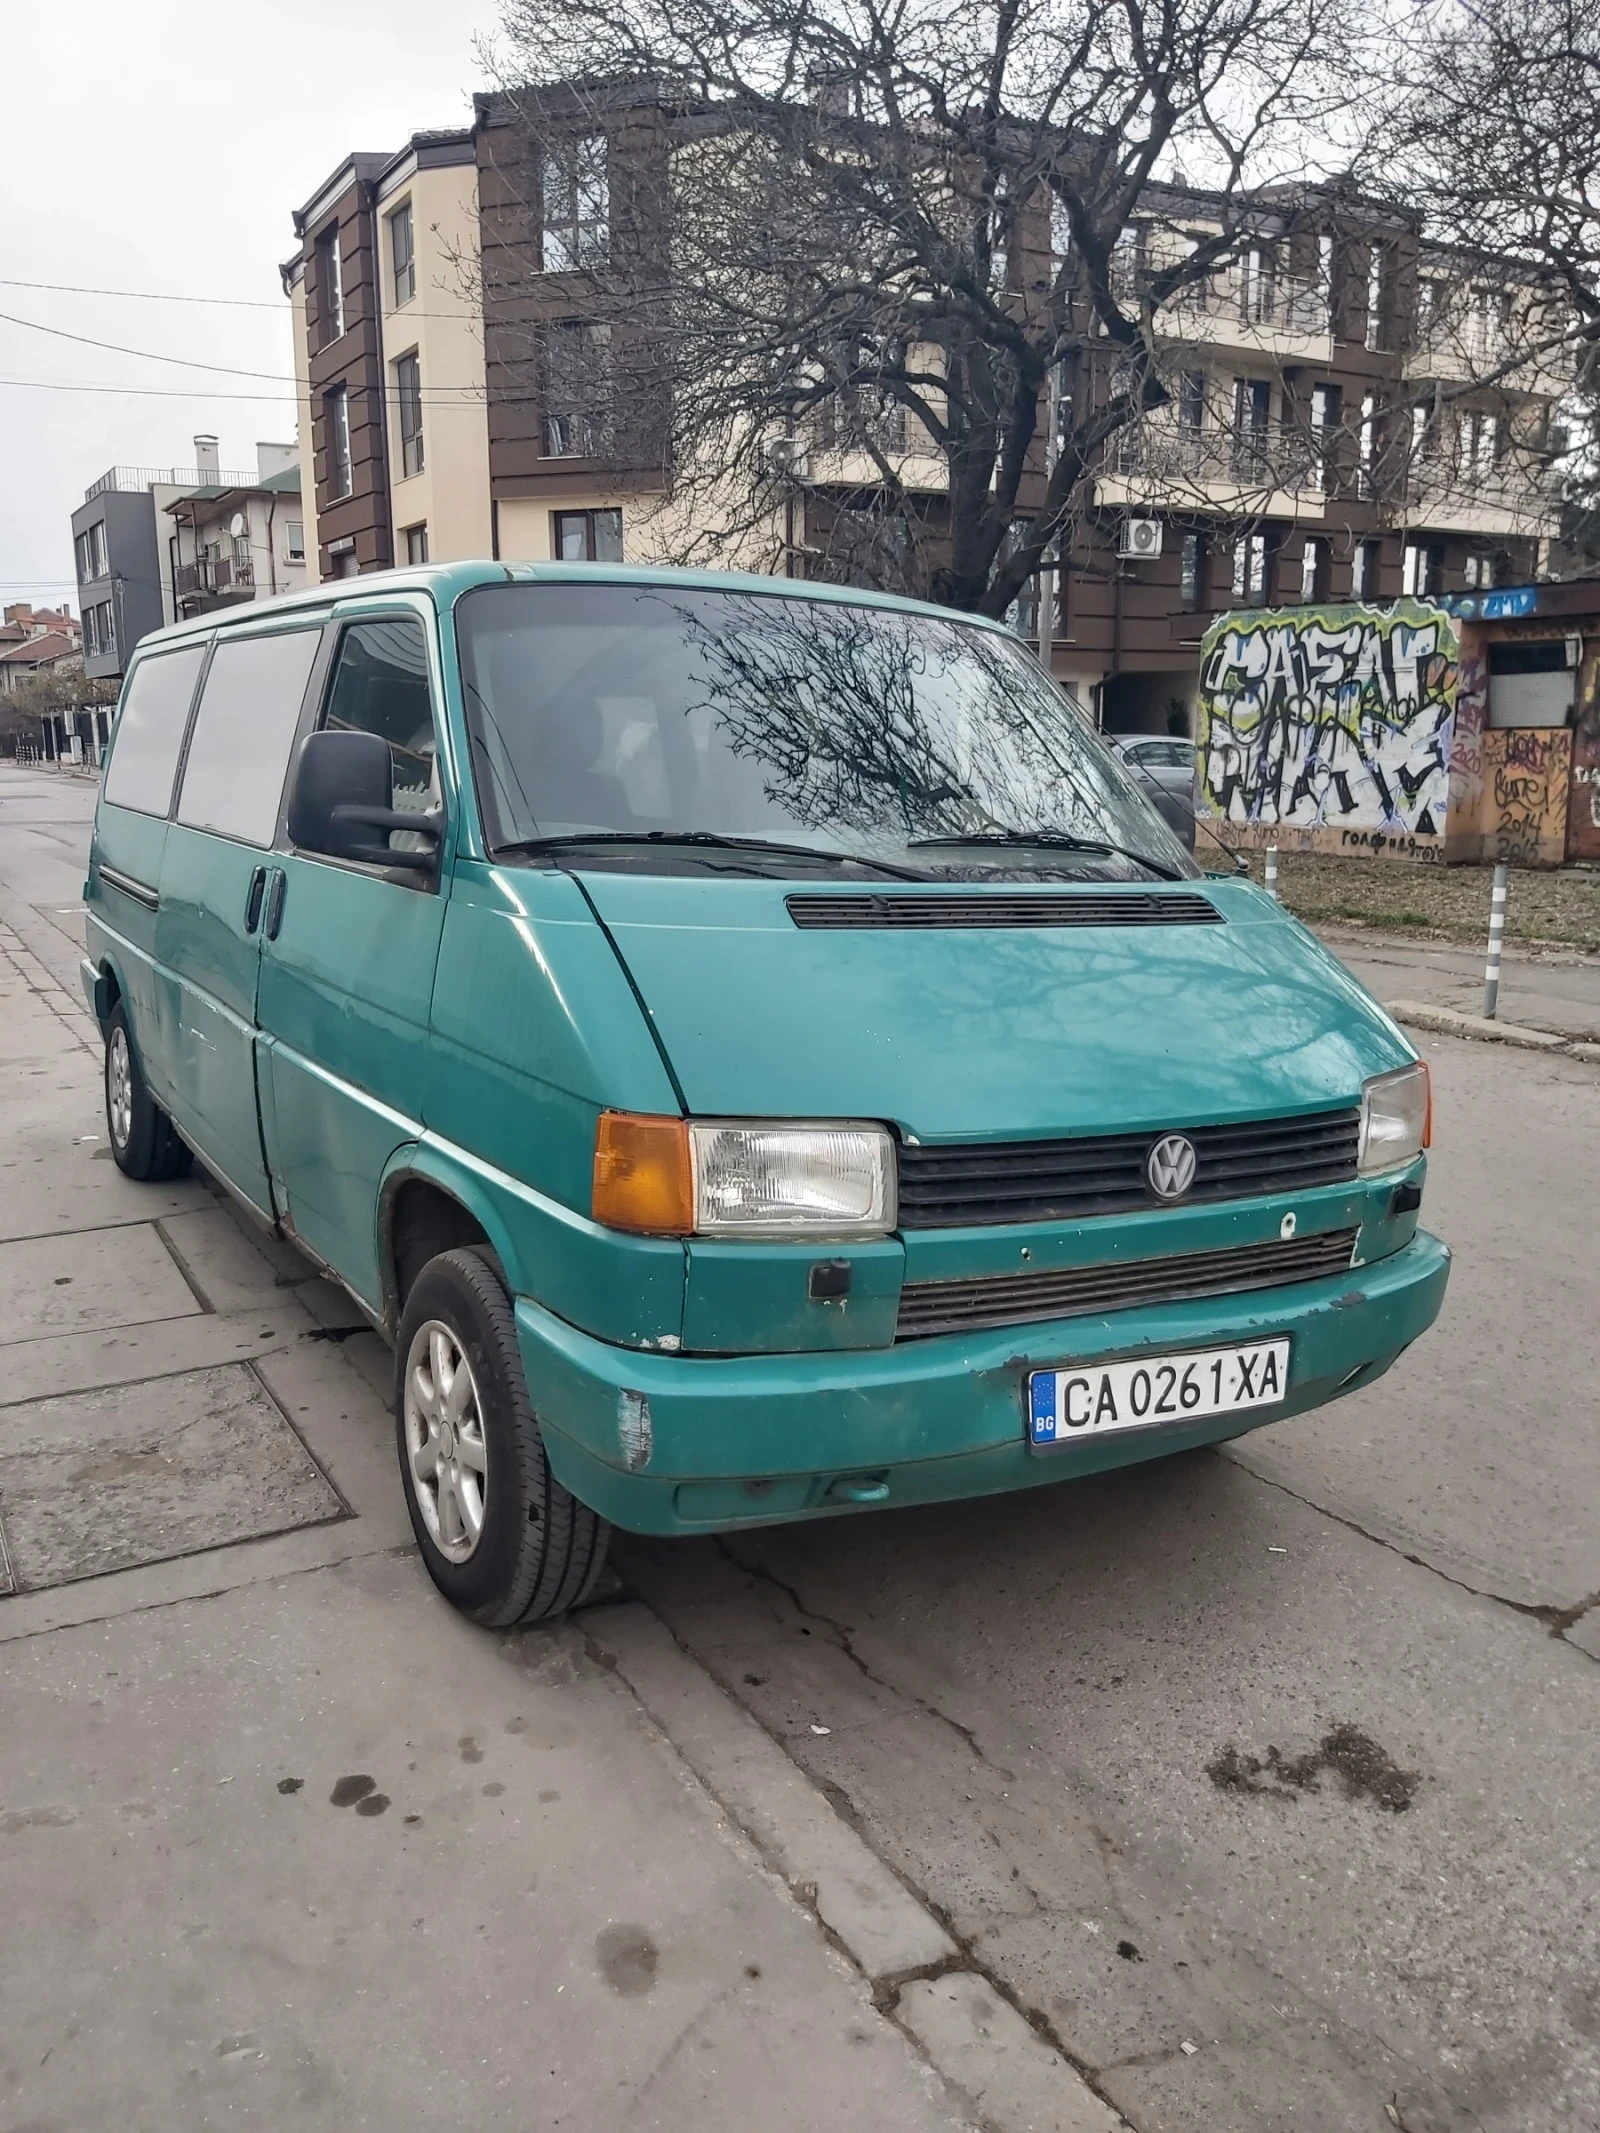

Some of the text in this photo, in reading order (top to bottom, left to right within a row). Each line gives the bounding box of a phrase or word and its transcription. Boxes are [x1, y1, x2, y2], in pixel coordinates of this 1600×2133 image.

[1496, 811, 1544, 844] 2014
[1064, 1350, 1279, 1427] CA 0261 XA
[1036, 1415, 1055, 1433] BG
